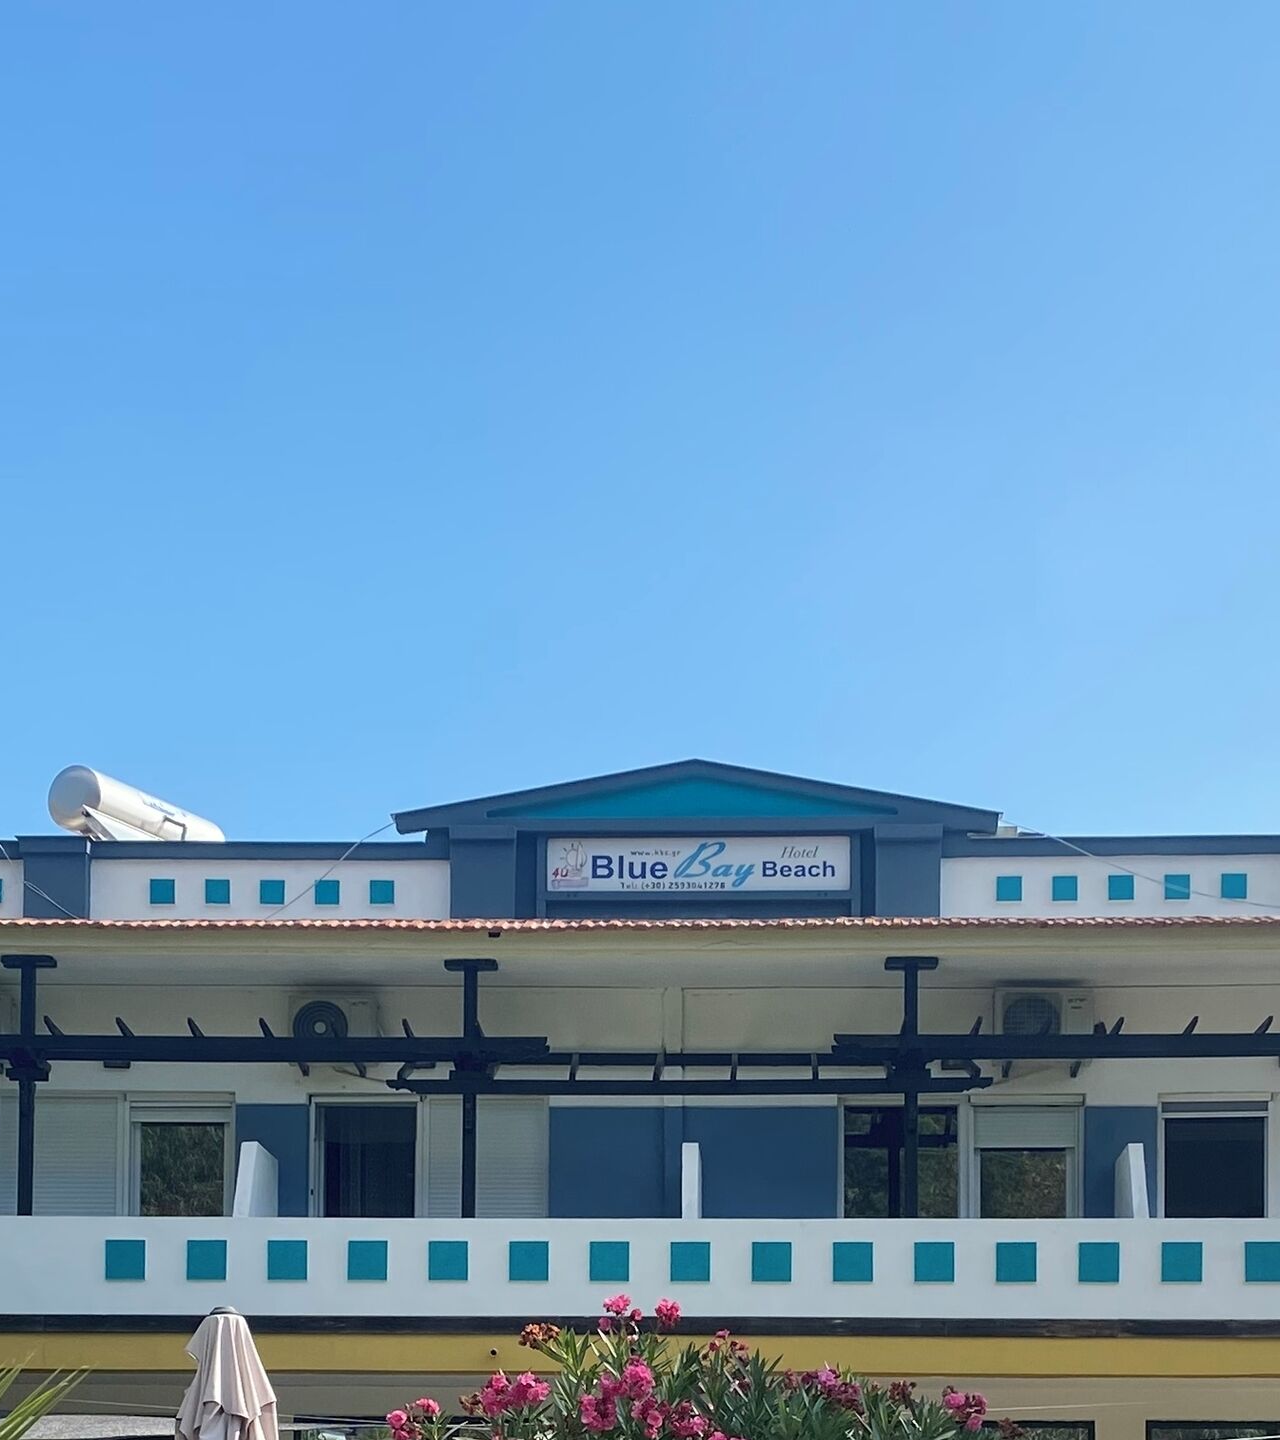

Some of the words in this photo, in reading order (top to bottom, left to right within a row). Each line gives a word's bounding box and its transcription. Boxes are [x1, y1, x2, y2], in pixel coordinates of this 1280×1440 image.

[591, 855, 669, 880] Blue
[673, 841, 756, 888] Bay
[761, 860, 836, 878] Beach
[780, 845, 819, 859] Hotel
